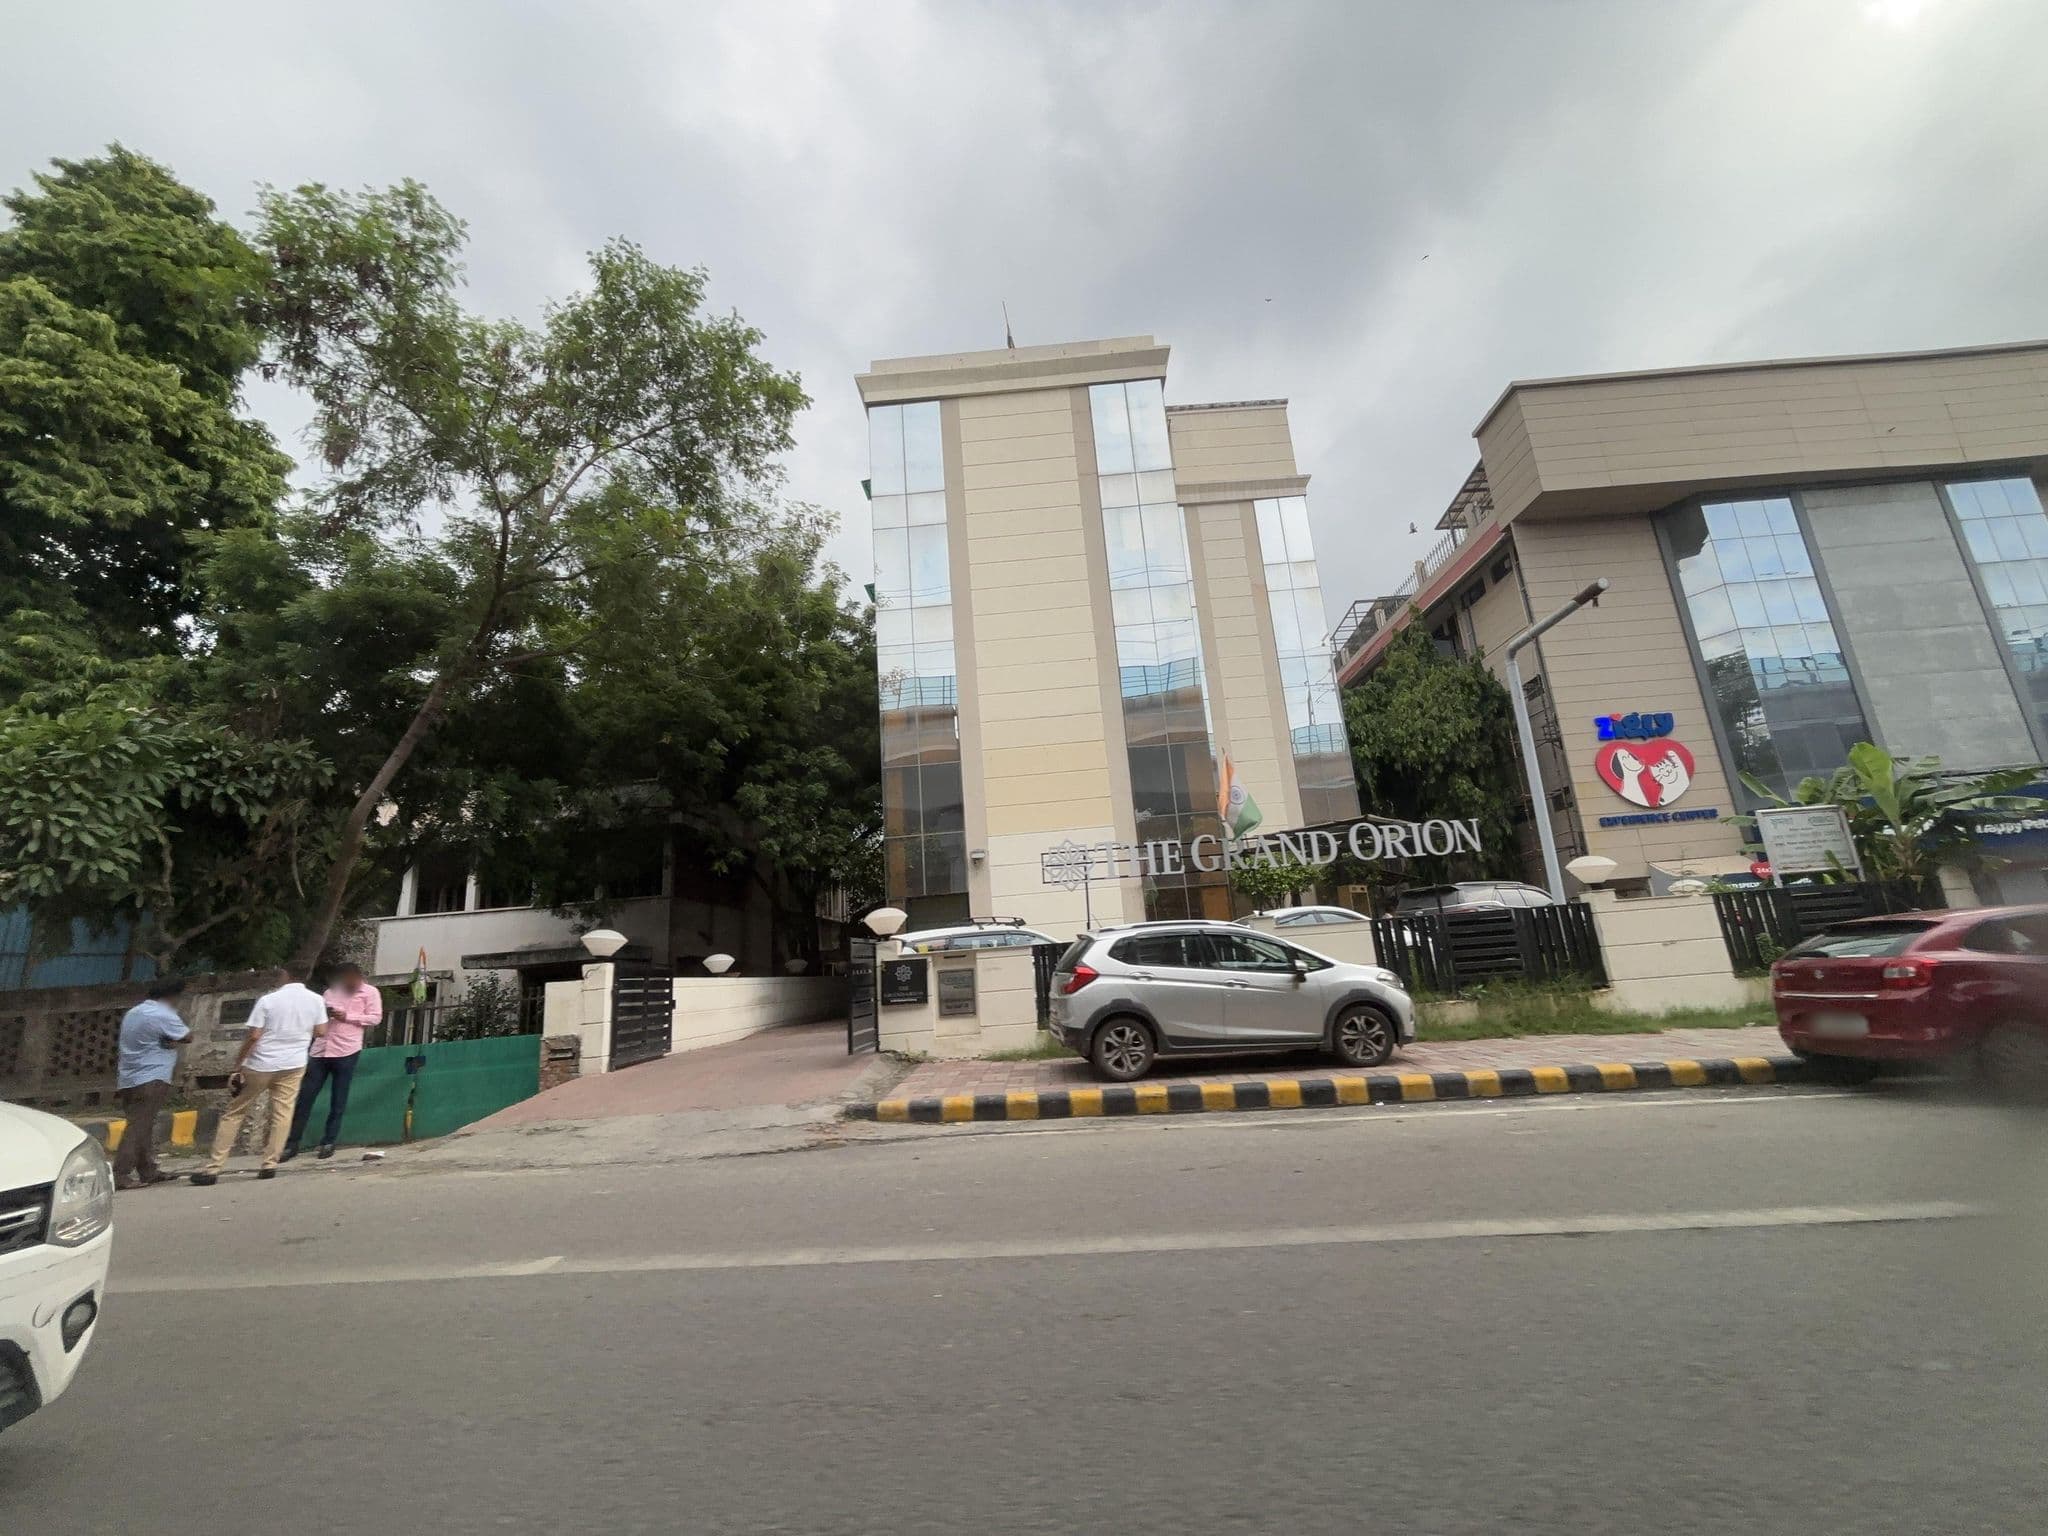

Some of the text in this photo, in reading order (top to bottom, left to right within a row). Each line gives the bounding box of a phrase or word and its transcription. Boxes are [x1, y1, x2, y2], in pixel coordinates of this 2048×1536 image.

[1095, 818, 1483, 878] THE GRAND ORION
